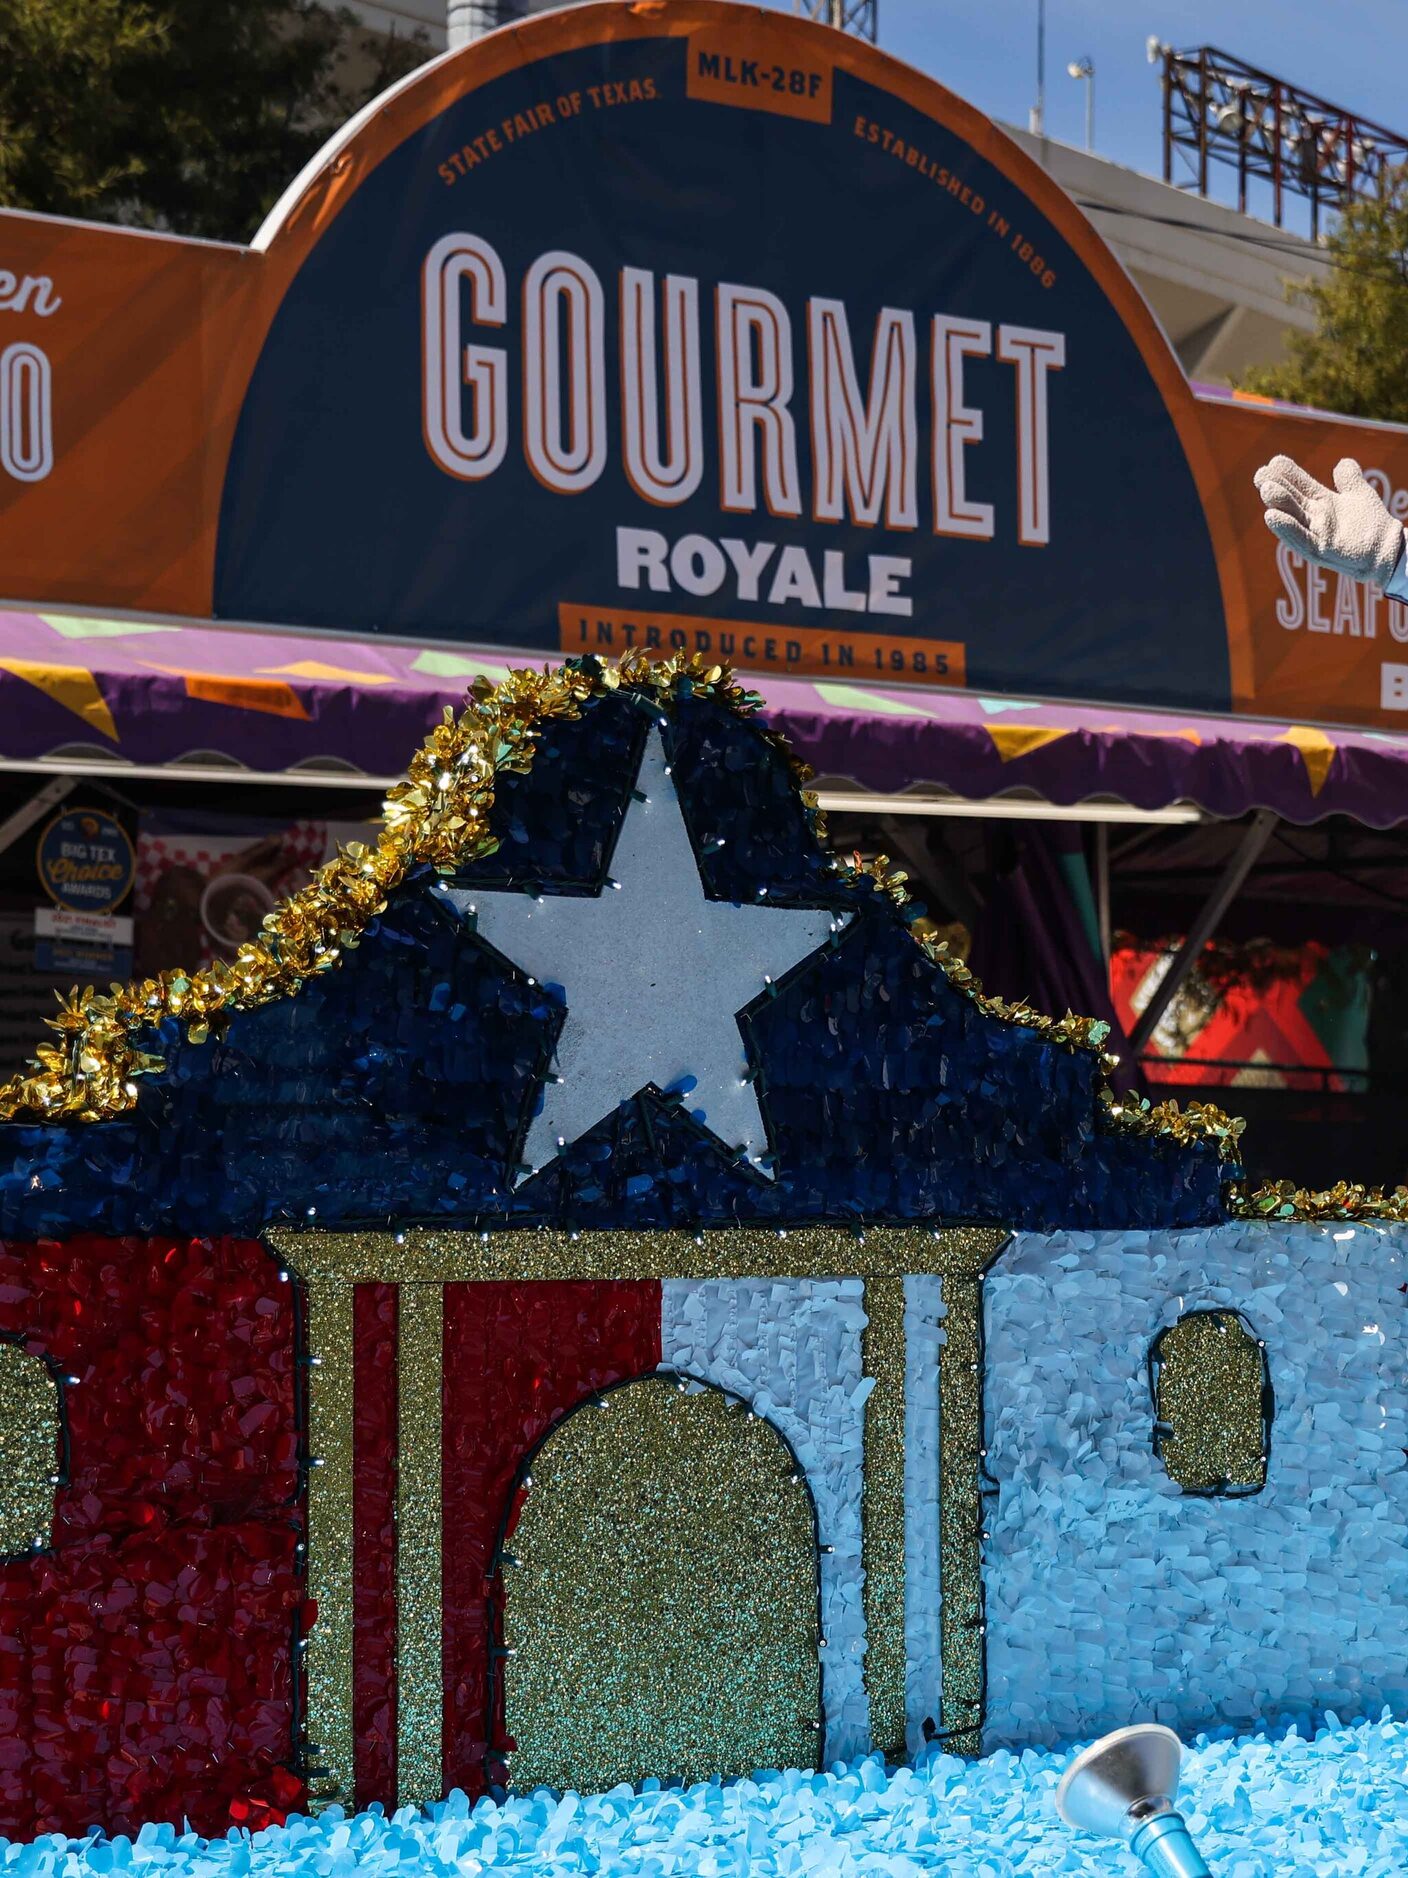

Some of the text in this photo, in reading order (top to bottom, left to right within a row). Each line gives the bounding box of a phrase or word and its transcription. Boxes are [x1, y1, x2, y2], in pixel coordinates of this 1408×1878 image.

[698, 52, 823, 99] MLK-28F
[437, 77, 658, 186] STATE FAIR OF TEXAS
[854, 115, 1057, 288] ESTABLISHED IN 1886
[421, 231, 1066, 548] GOURMET
[616, 526, 913, 617] ROYALE
[579, 618, 950, 676] INTRODUCED IN 1985
[47, 857, 125, 883] Choice
[60, 841, 117, 863] BIG TEX
[61, 882, 113, 900] AWARDS
